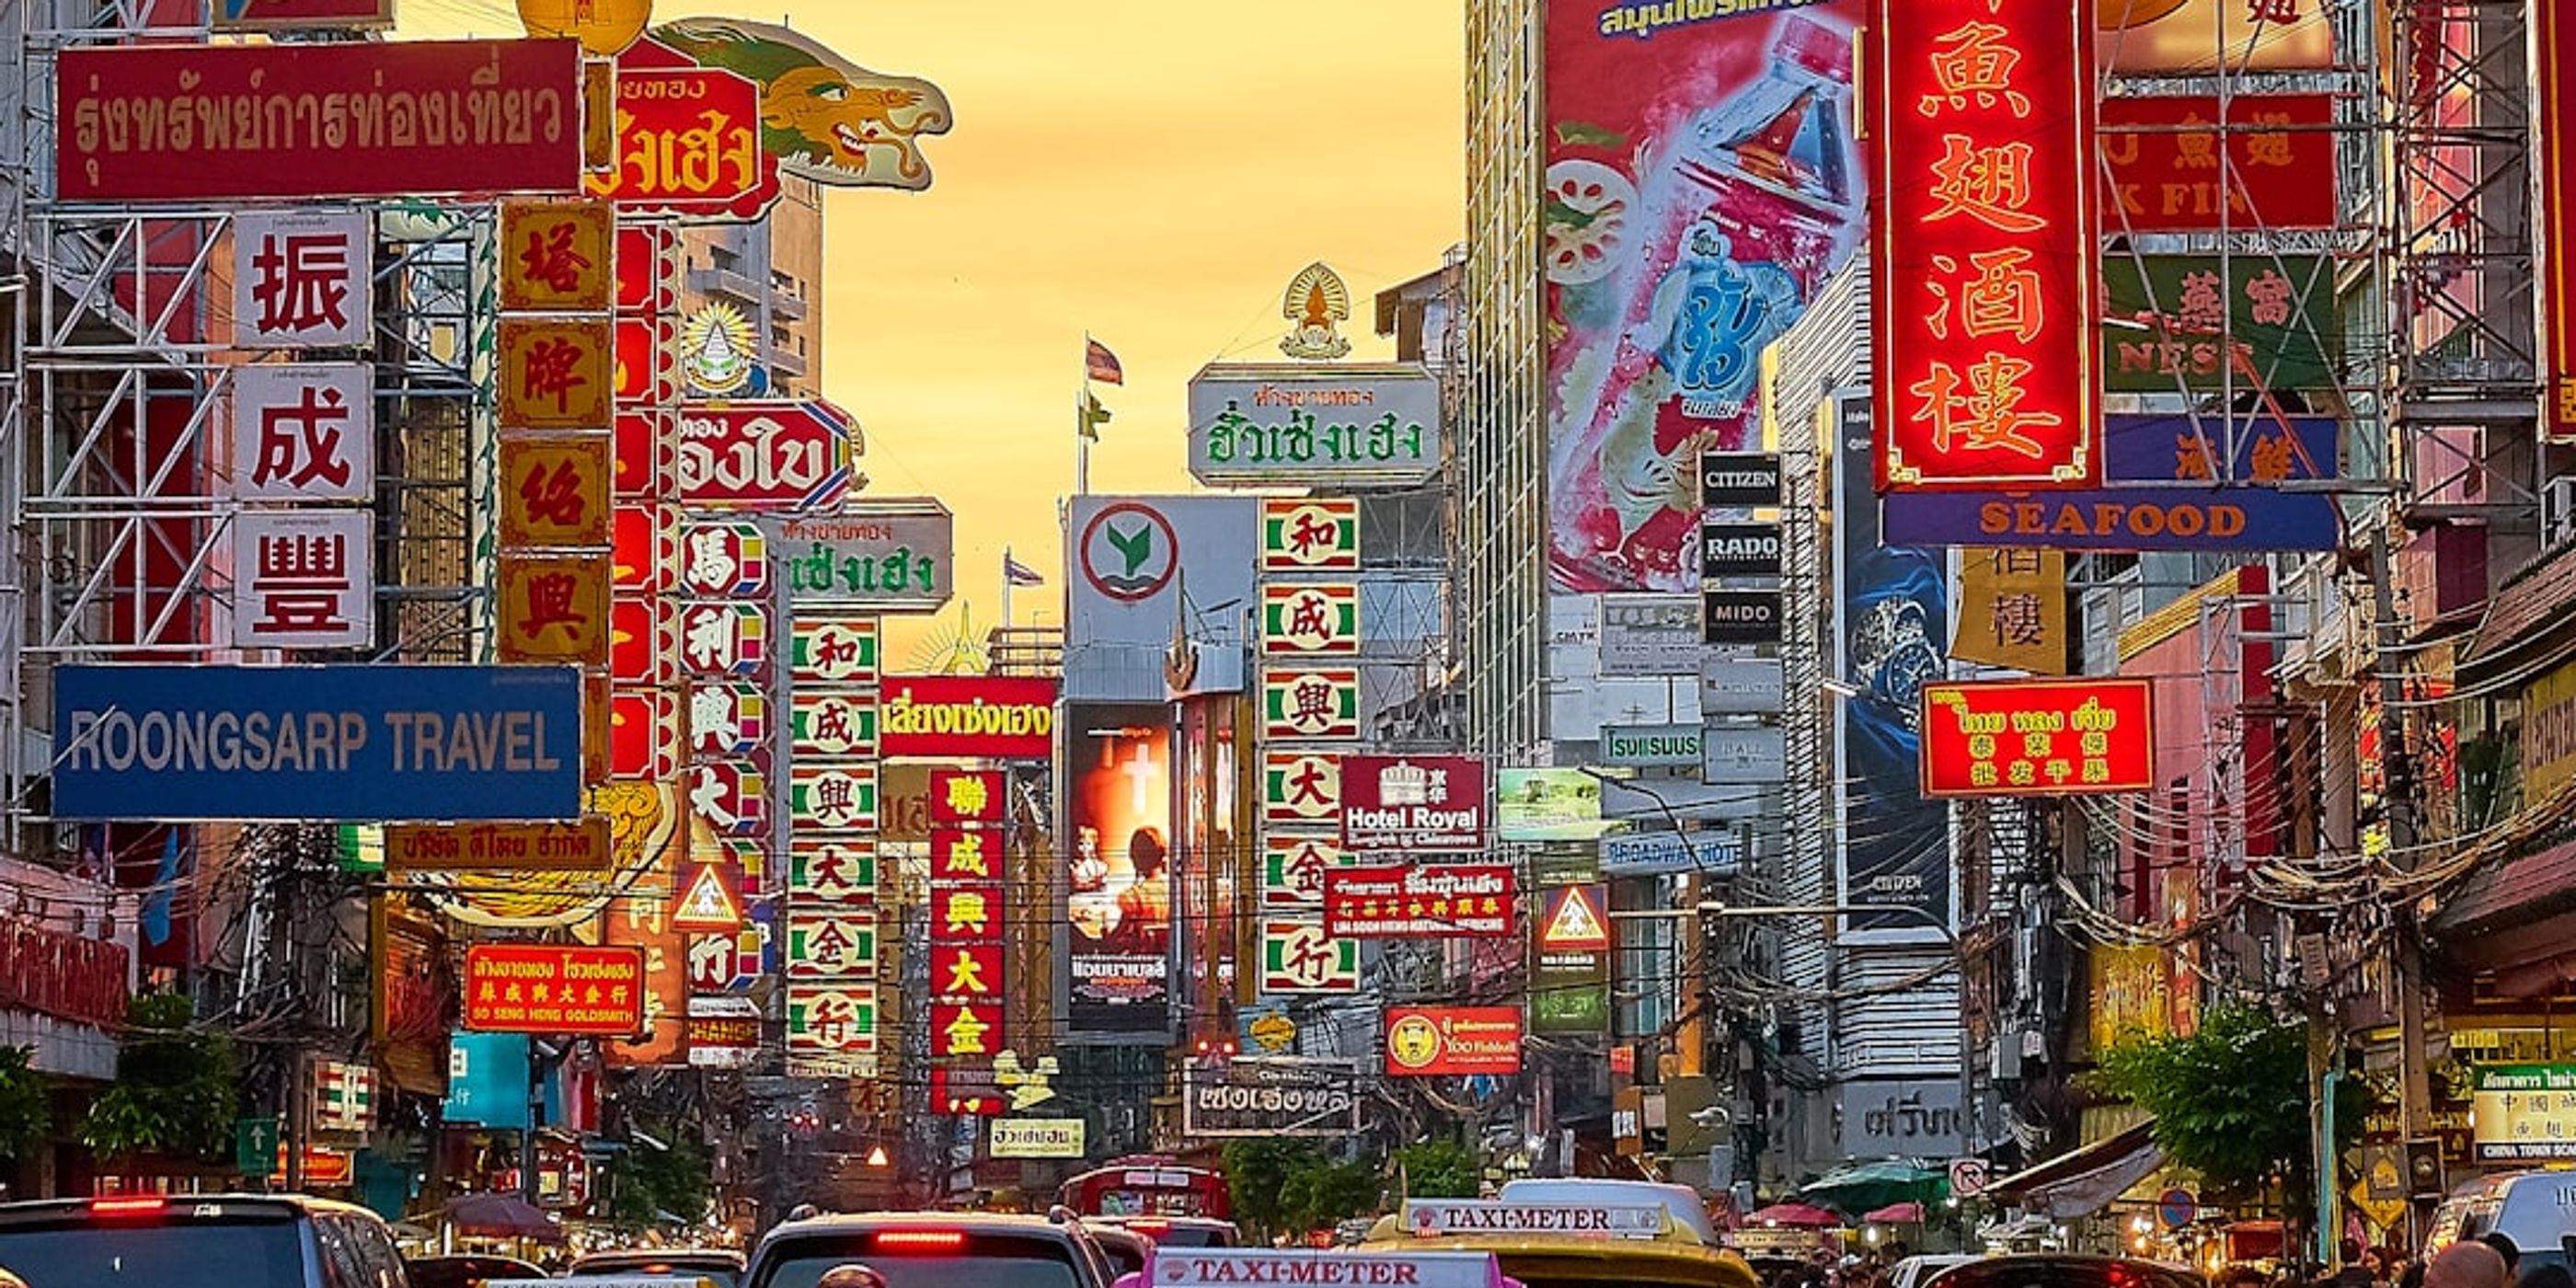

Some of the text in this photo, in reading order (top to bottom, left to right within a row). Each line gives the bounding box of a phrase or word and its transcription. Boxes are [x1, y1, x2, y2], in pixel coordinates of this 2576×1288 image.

[616, 79, 707, 99] ยทอง
[74, 44, 562, 186] รุ่งทรัพย์การท่องเที่ยว
[586, 109, 753, 192] งเฮง
[2162, 183, 2246, 215] FIN
[1909, 0, 2061, 458] 魚翅酒樓
[252, 234, 351, 633] 振成豐
[680, 419, 729, 439] ทอง
[680, 417, 824, 492] องใบ
[1705, 471, 1777, 489] CITIZEN
[1979, 502, 2247, 538] SEAFOOD
[1708, 536, 1778, 555] RADO
[788, 543, 935, 592] เซ่งเฮง
[1715, 604, 1771, 621] MIDO
[71, 710, 560, 771] ROONGSARP TRAVEL
[687, 529, 738, 984] 馬利興大行
[1288, 512, 1339, 981] 和成興大金行
[1607, 730, 1698, 758] โรงแรมบร
[1347, 807, 1478, 833] Hotel Royal
[810, 632, 858, 1042] 和成興大金行
[1702, 844, 1742, 864] HOTE
[944, 775, 990, 1111] 聯成興大金
[564, 1009, 634, 1023] GOLDSMITH
[2483, 1144, 2576, 1158] CHINA TOWN SCA
[1443, 1208, 1611, 1232] TAXI-METER
[1193, 1259, 1420, 1284] TAXI-METER
